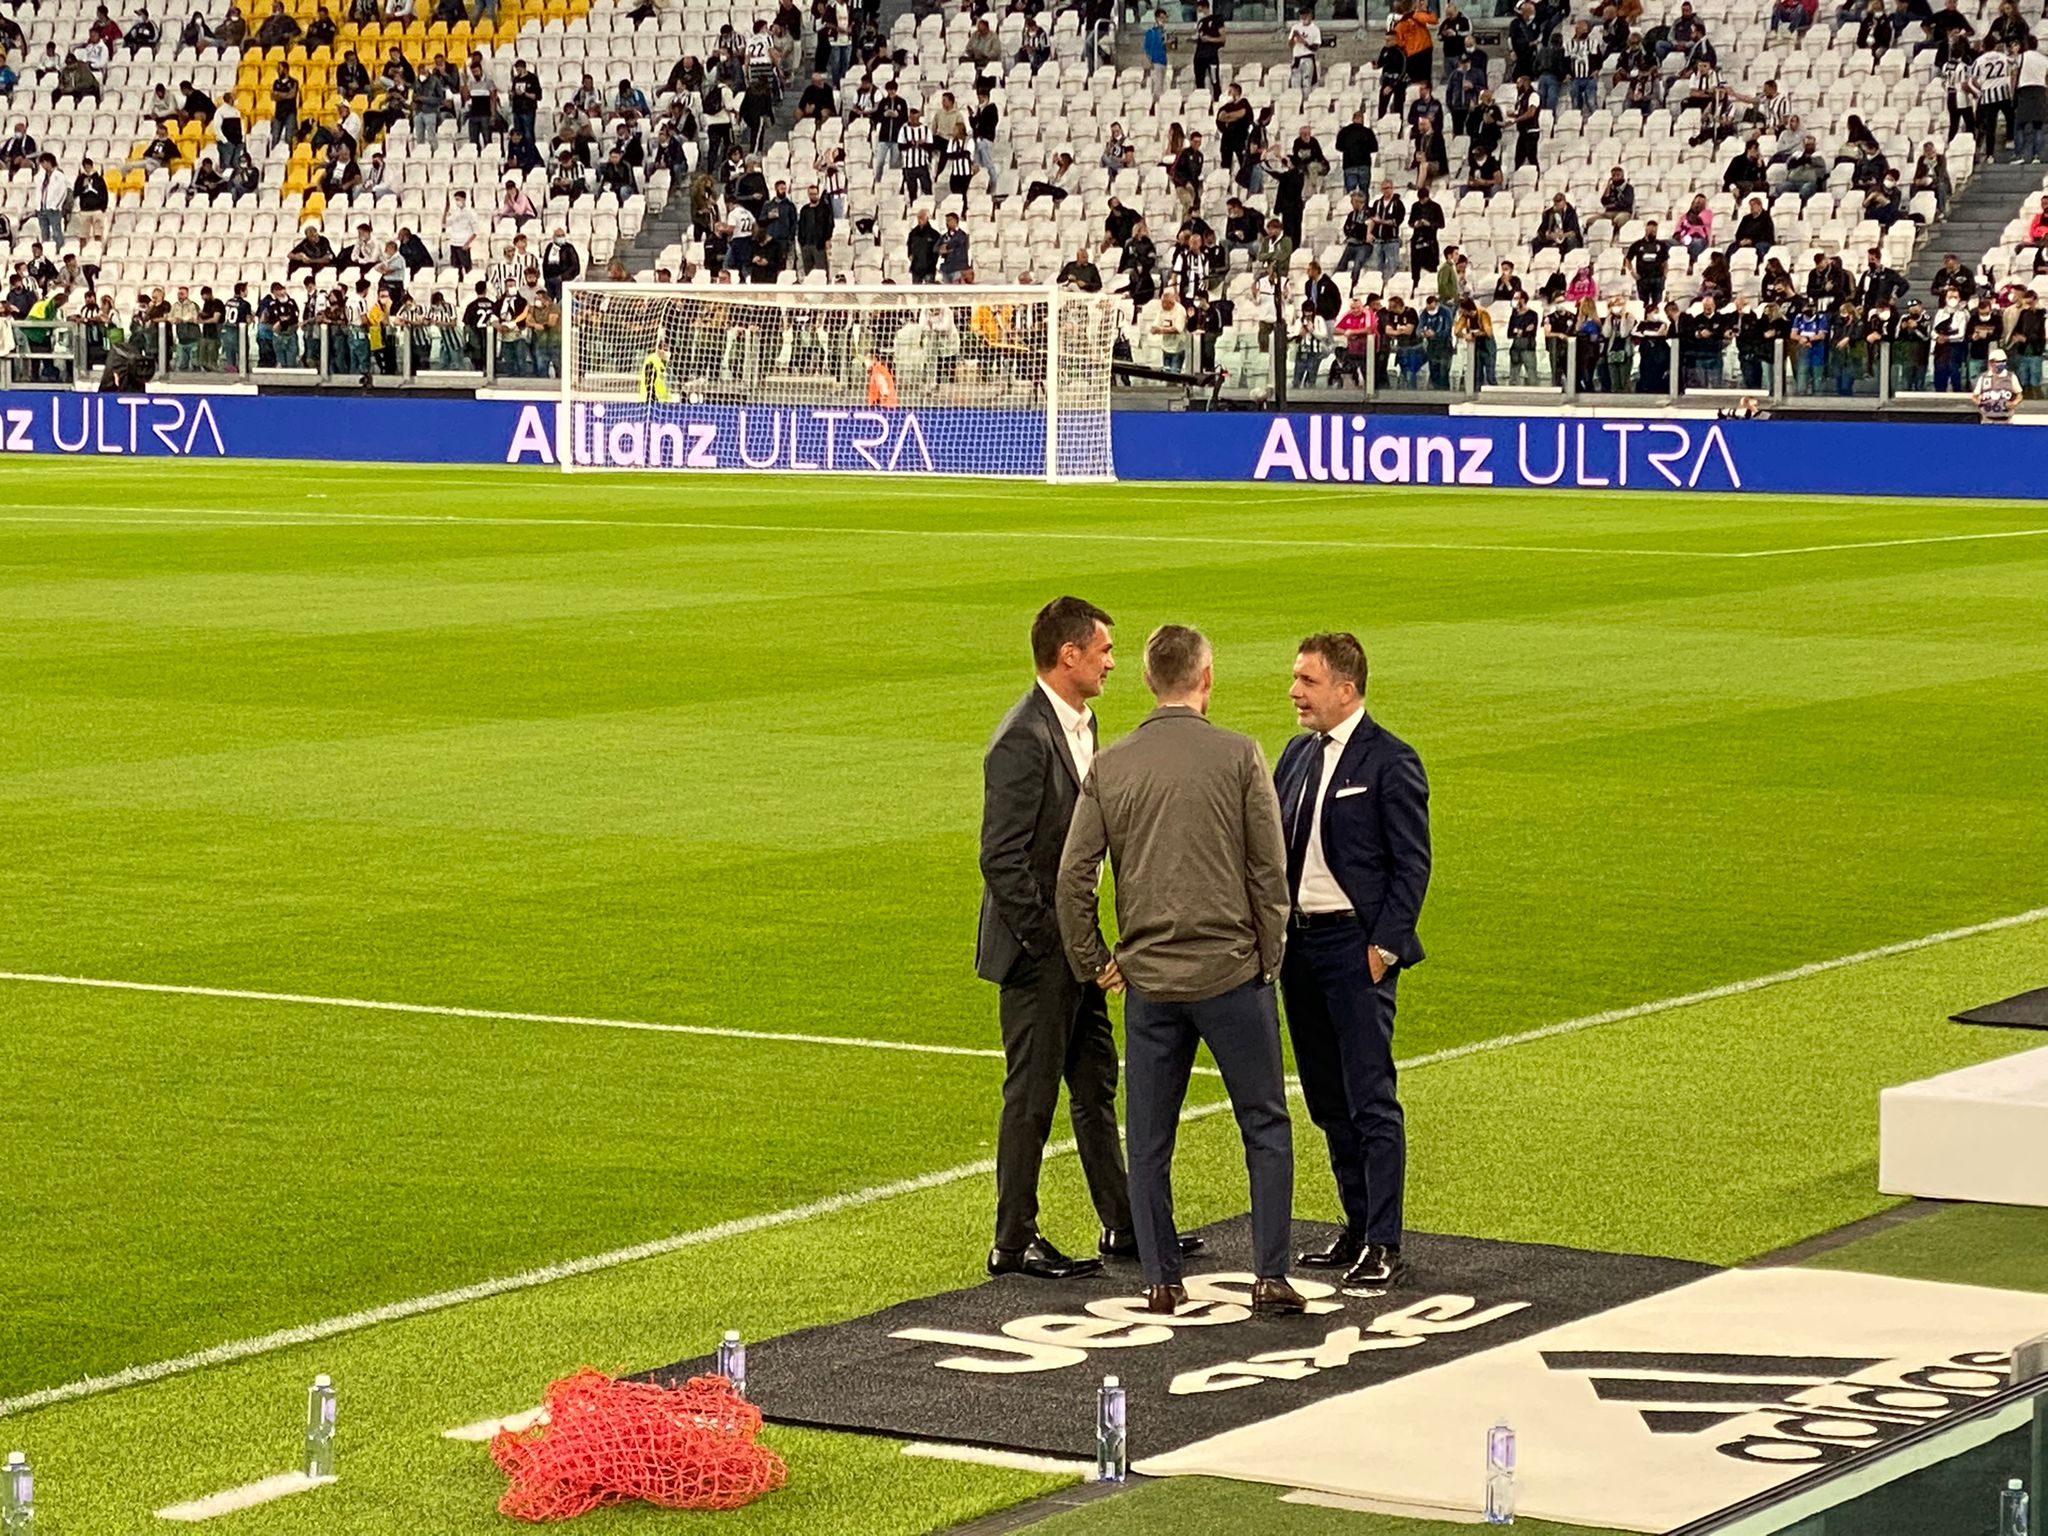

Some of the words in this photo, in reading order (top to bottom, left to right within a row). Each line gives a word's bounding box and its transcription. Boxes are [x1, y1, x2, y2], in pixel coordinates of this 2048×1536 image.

[749, 42, 765, 57] 22
[1985, 60, 2005, 79] 22
[0, 409, 34, 451] z
[52, 396, 225, 455] ULTRA
[740, 410, 934, 471] ULTRA
[1253, 415, 1494, 485] Allianz
[1518, 422, 1741, 489] ULTRA
